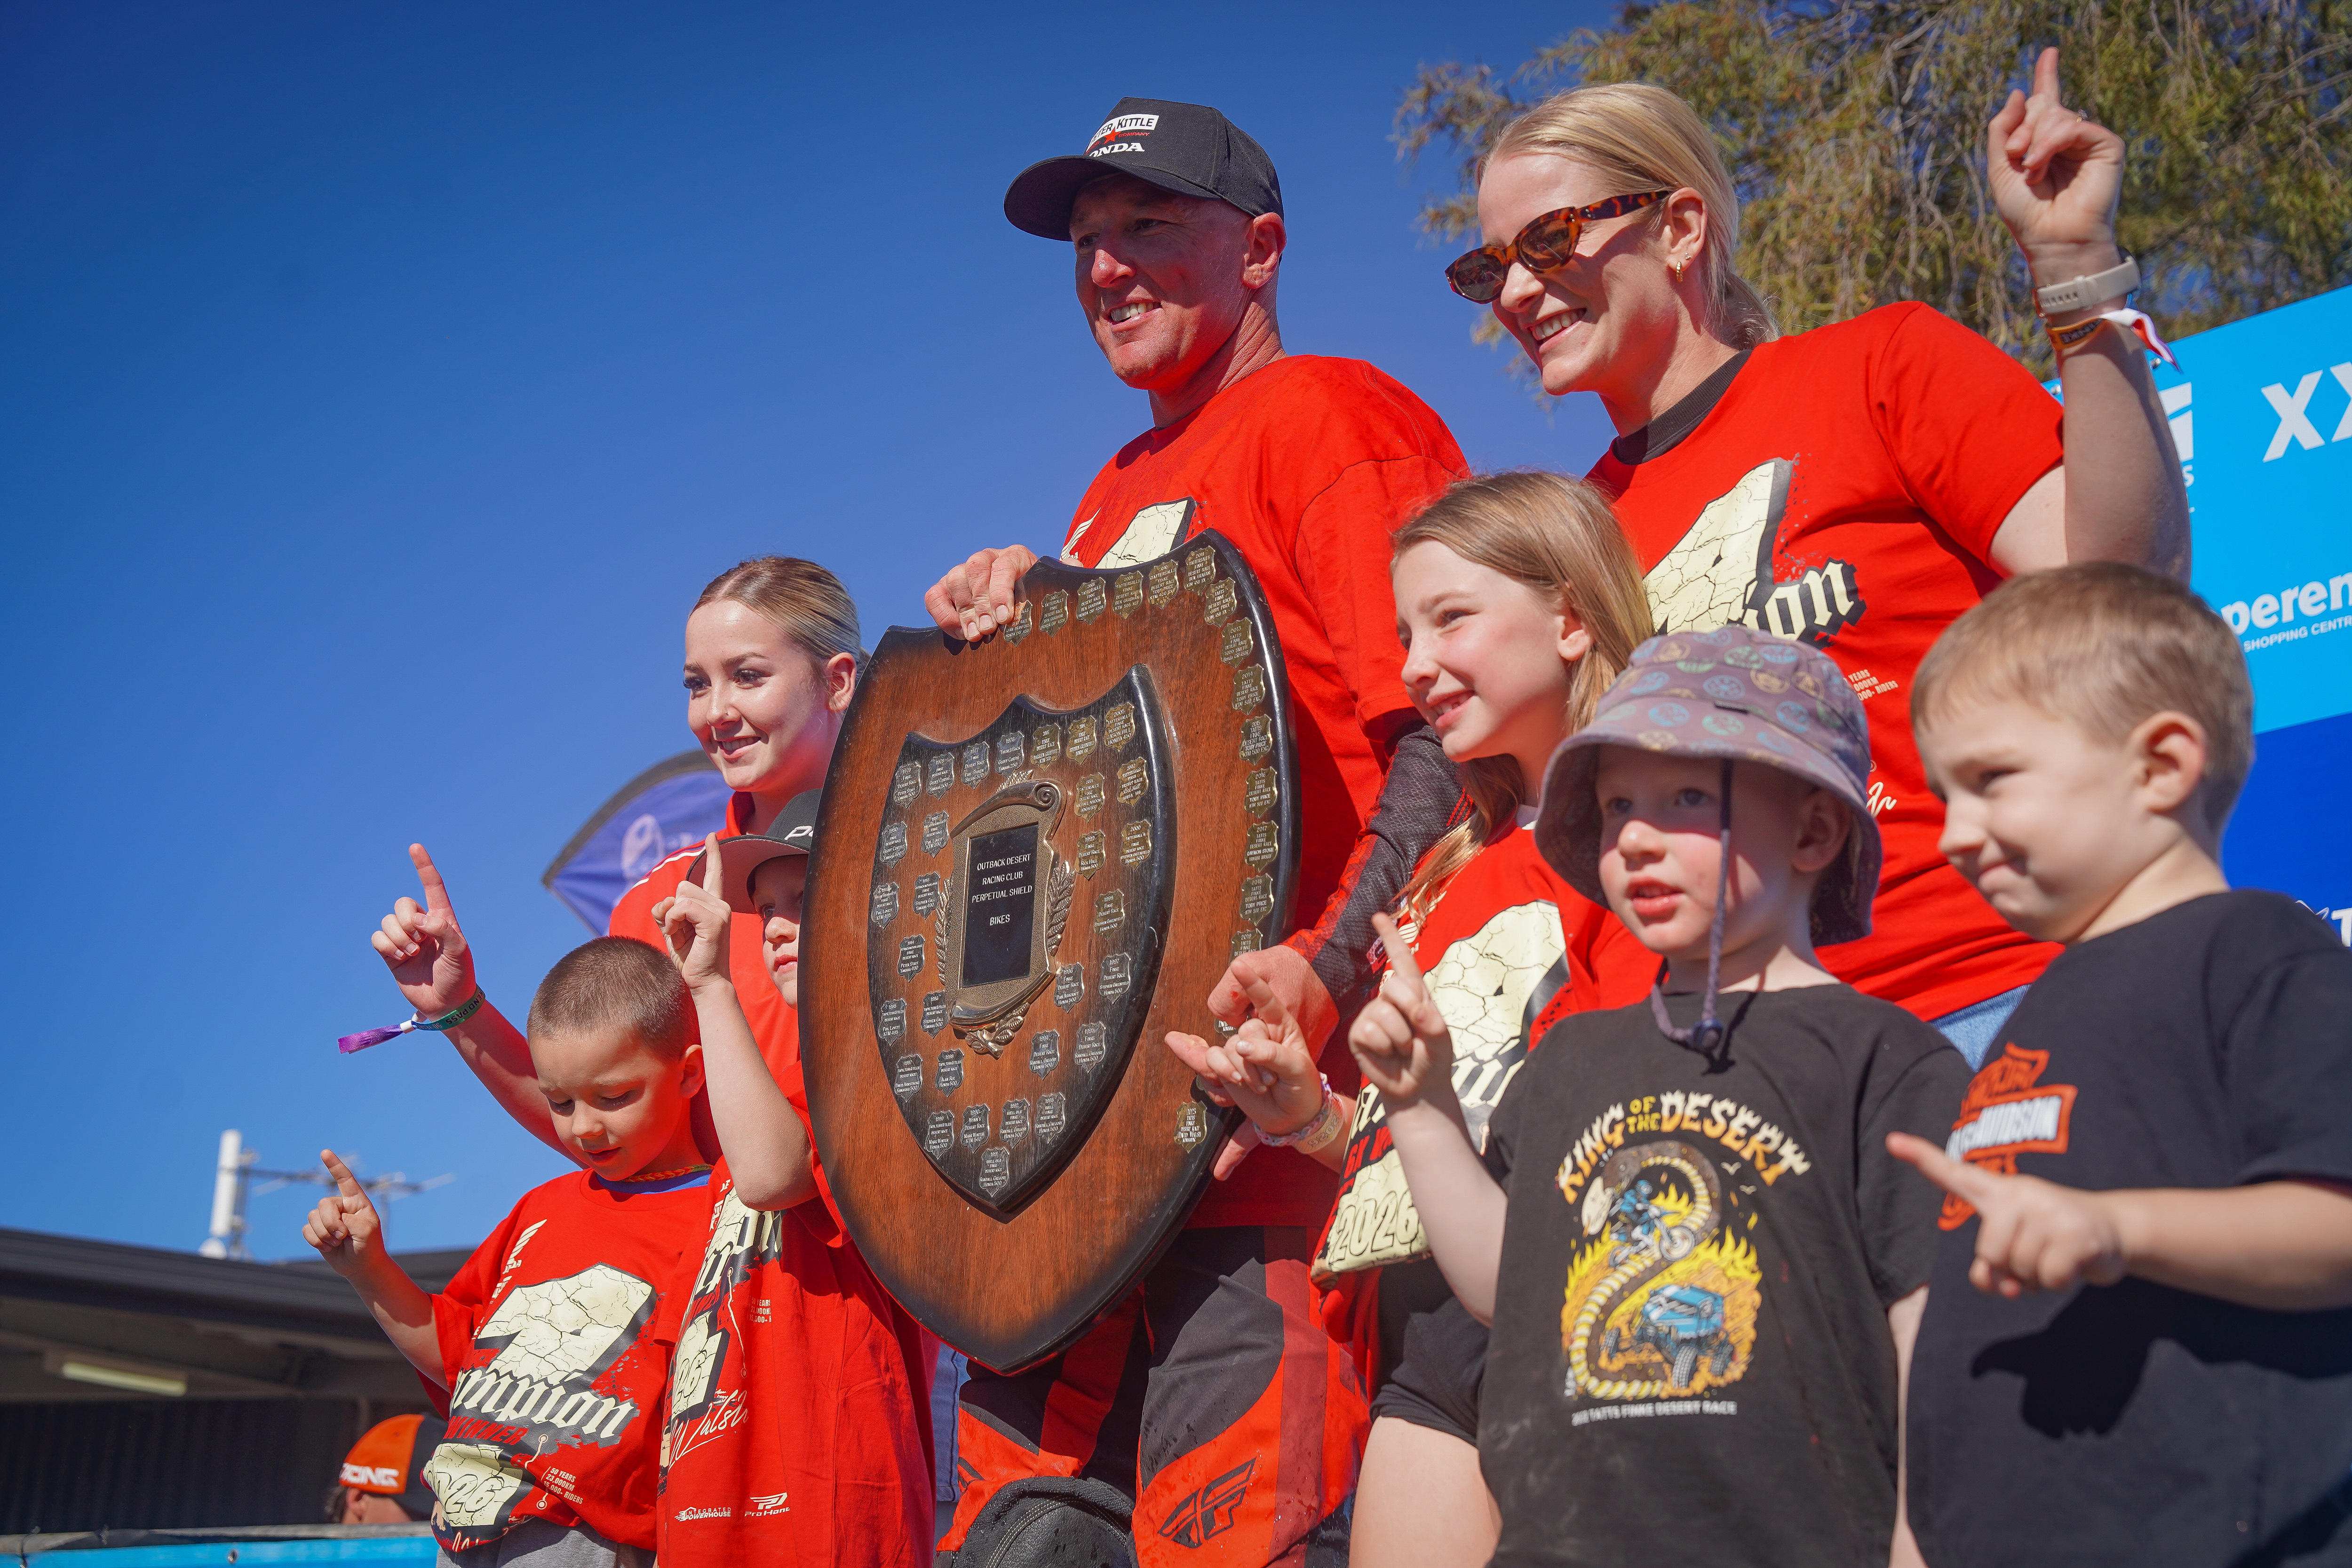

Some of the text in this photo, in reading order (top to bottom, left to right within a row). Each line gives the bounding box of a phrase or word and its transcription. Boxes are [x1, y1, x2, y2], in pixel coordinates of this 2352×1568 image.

[1117, 118, 1154, 129] KITTLE
[1089, 143, 1145, 157] ONDA
[2221, 572, 2352, 636] peren
[2243, 615, 2352, 653] SHOPPING CENTR
[1848, 669, 1871, 683] YEARS
[1853, 677, 1880, 692] 000KM
[1875, 680, 1899, 694] RIDERS
[1108, 736, 1122, 745] HONDA
[1242, 738, 1258, 747] DESERT
[977, 853, 1031, 871] OUTBACK DESERT
[982, 871, 1023, 885] RACING CLUB
[972, 885, 1033, 903] PERPETUAL SHIELD
[990, 914, 1010, 926] BIKES
[1555, 1089, 1811, 1205] KING OF THE DESERT
[1329, 1190, 1420, 1266] 2026
[452, 1369, 634, 1439] mpion
[1655, 1400, 1701, 1416] DESERT
[1701, 1400, 1738, 1416] RACE
[444, 1416, 529, 1445] WINNER
[545, 1473, 575, 1492] 23,000KM
[558, 1470, 576, 1483] YEARS
[564, 1491, 583, 1504] RIDERS
[685, 1511, 731, 1521] POWERHOUSE
